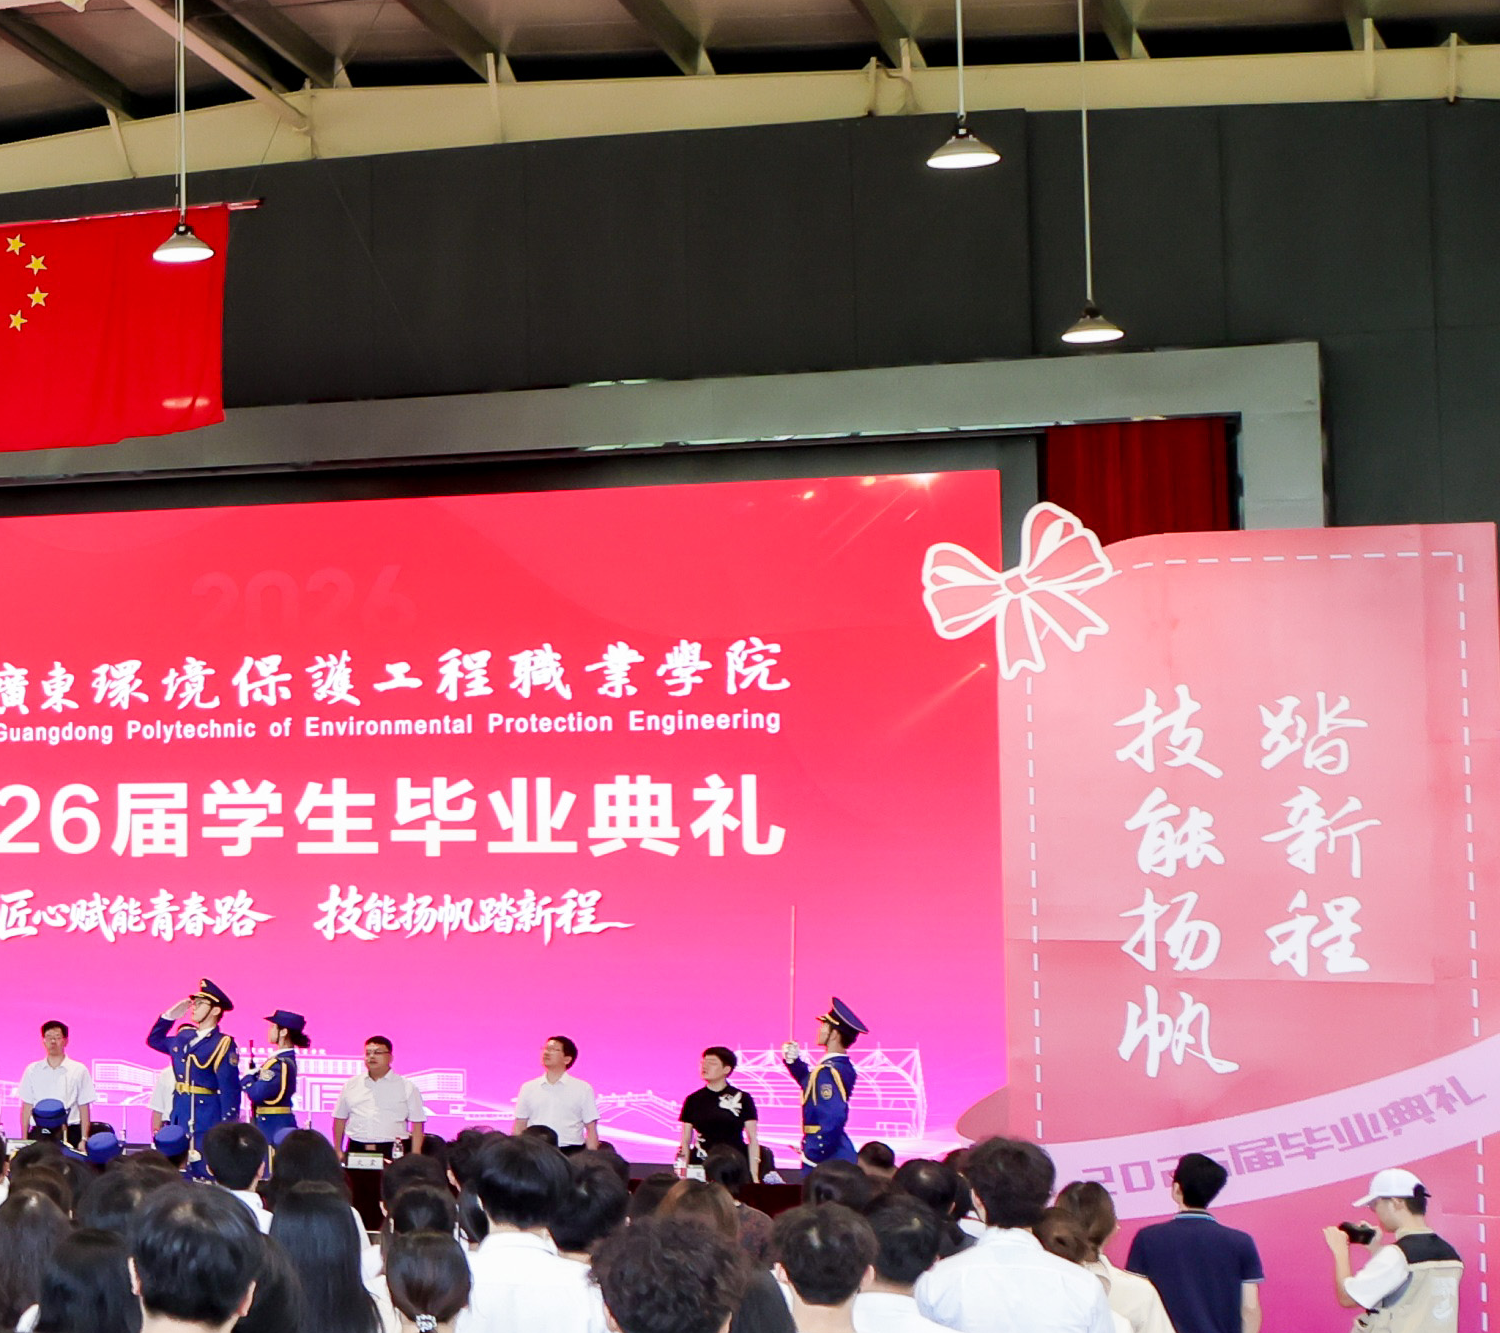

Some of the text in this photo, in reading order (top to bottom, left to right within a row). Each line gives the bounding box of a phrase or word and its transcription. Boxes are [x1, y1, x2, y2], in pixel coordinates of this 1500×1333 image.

[127, 718, 256, 744] Polytechnic
[269, 717, 293, 737] of
[305, 714, 473, 737] Environmental
[488, 711, 613, 733] Protection
[629, 709, 780, 735] Engineering
[312, 883, 635, 946] 技能扬帆踏新程
[1113, 683, 1240, 1078] 技能扬帆
[1257, 689, 1382, 978] 踏新程
